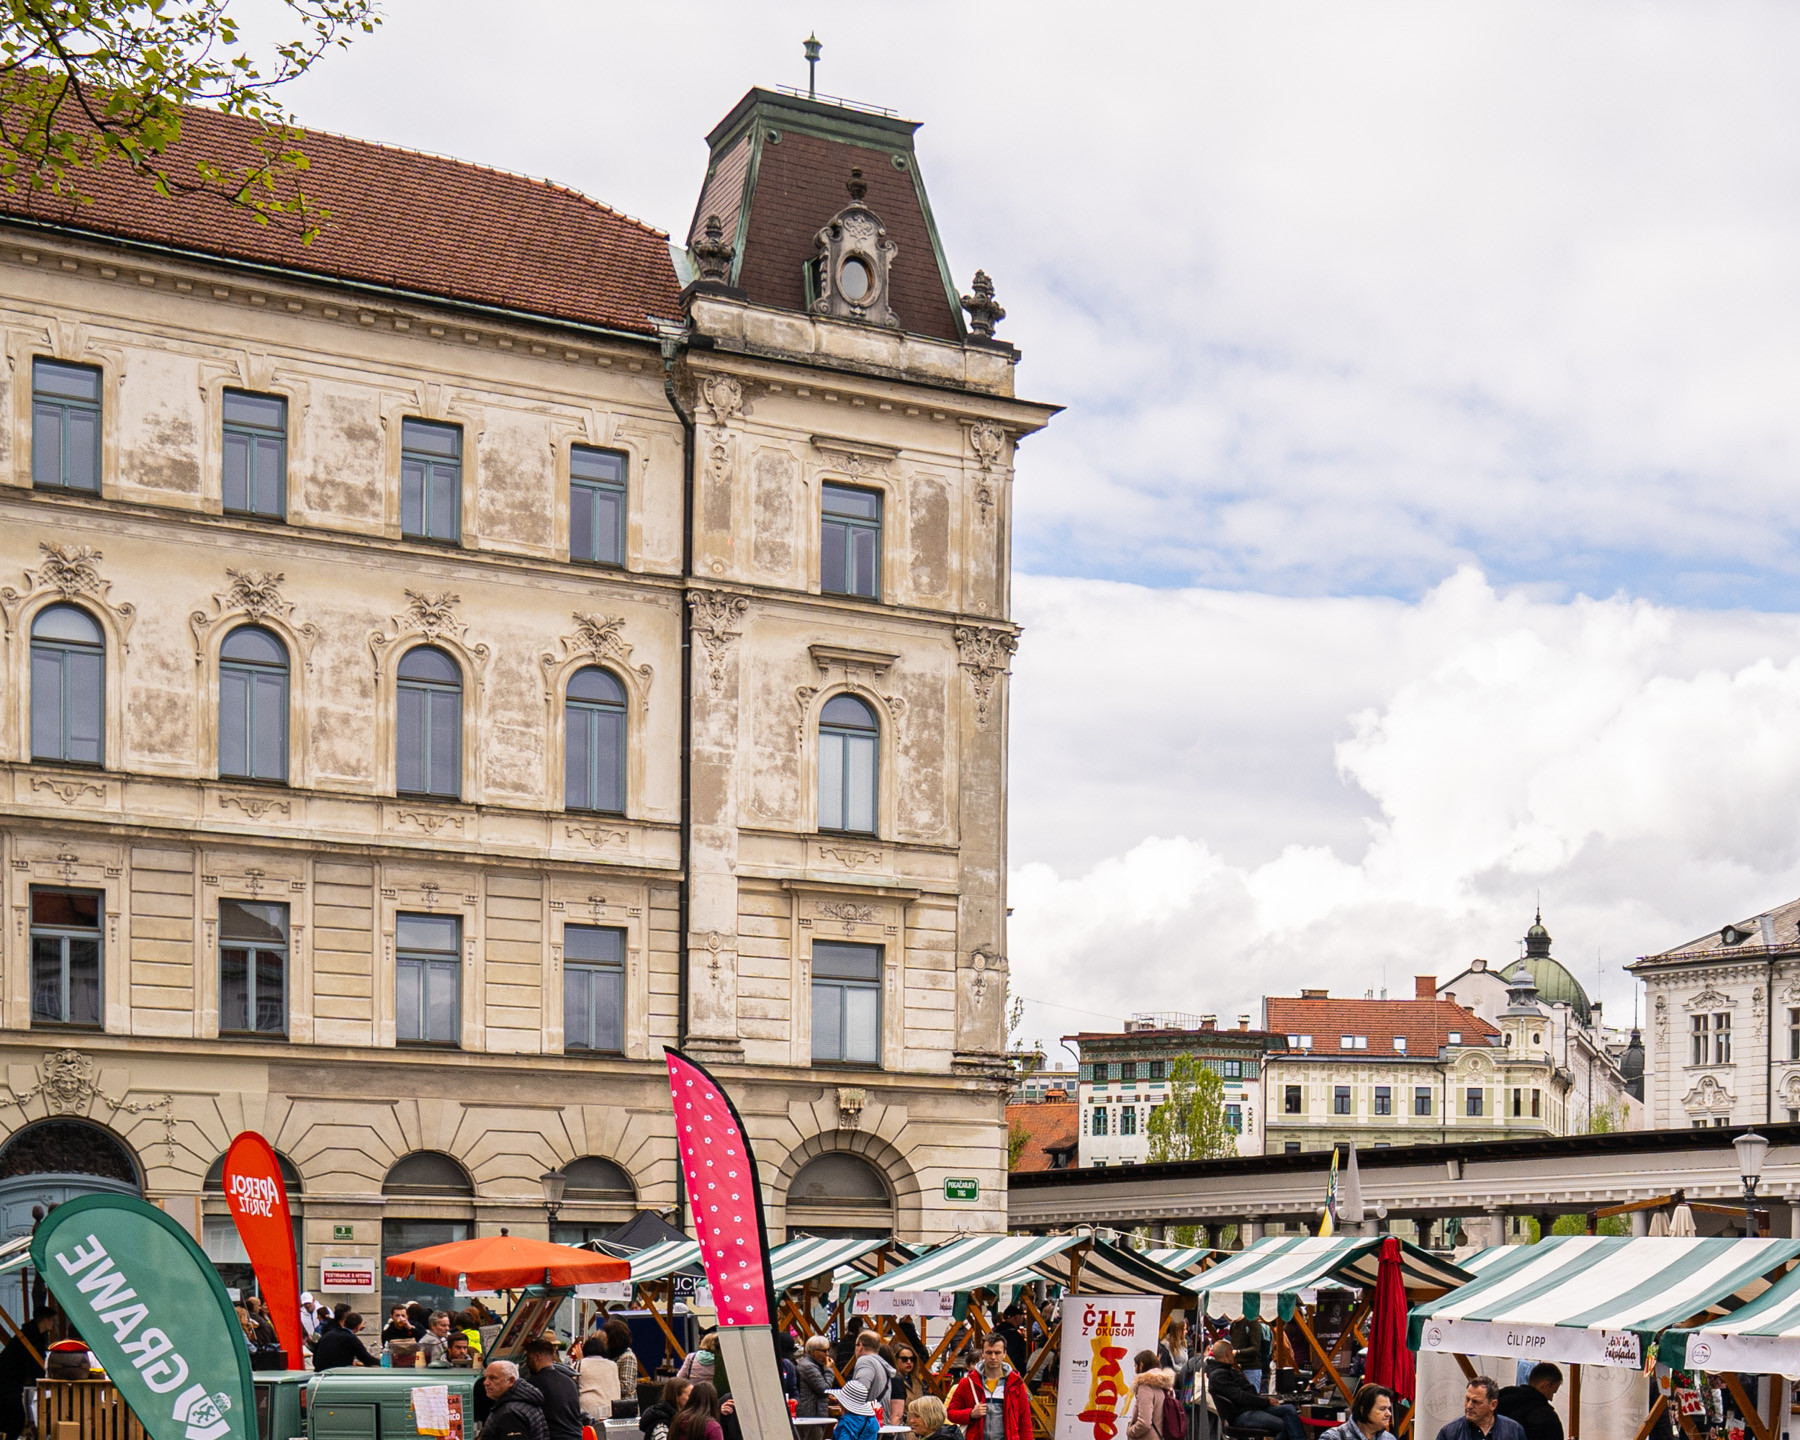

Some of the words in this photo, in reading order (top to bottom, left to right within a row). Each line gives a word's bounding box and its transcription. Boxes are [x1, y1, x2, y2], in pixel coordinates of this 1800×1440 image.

[1083, 1303, 1136, 1327] ČILI
[1082, 1327, 1088, 1336] Z
[1095, 1327, 1135, 1337] OKUSOM
[1507, 1332, 1524, 1346] ČILI
[1525, 1335, 1546, 1348] PIPP
